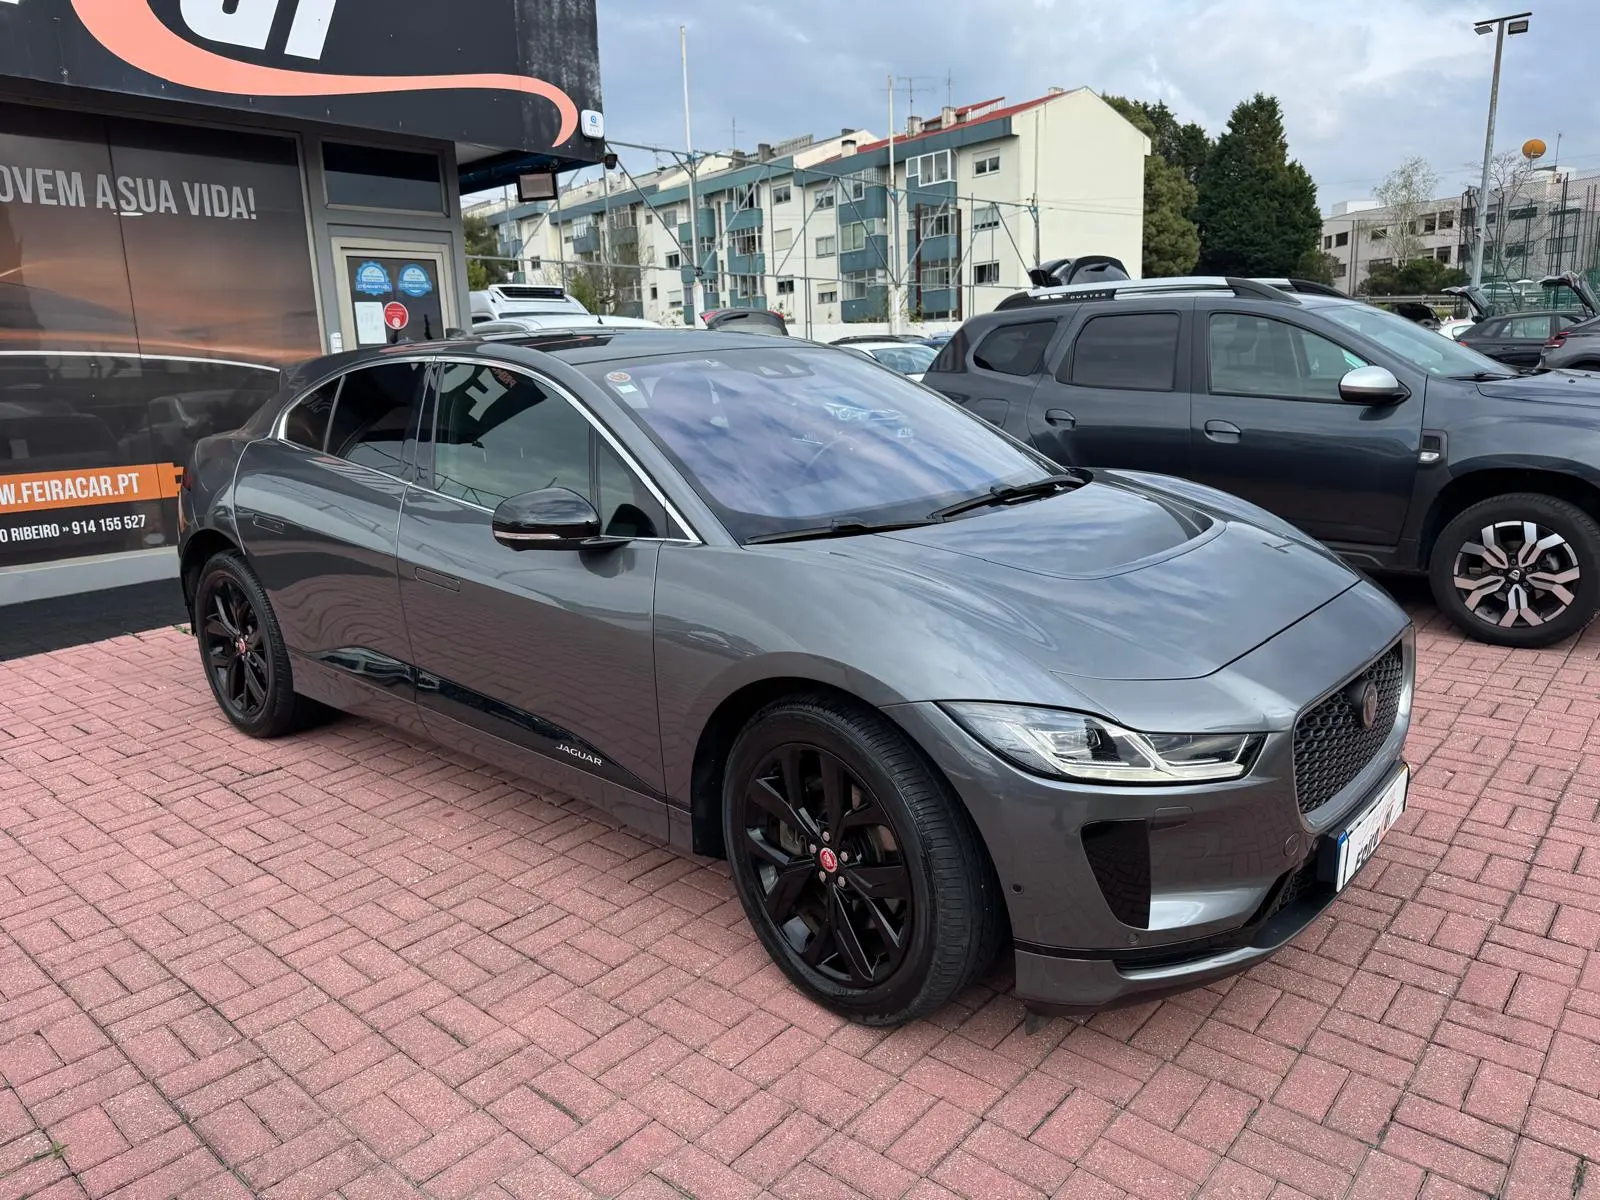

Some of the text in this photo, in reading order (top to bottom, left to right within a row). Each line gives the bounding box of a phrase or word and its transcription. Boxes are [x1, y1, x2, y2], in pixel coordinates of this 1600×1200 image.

[96, 173, 117, 209] A
[117, 175, 178, 214] SUA
[182, 181, 257, 220] VIDA!
[11, 523, 60, 541] RIBEIRO
[71, 519, 97, 535] 914
[99, 516, 122, 532] 155
[124, 514, 146, 529] 527
[555, 743, 603, 767] JAGUAR
